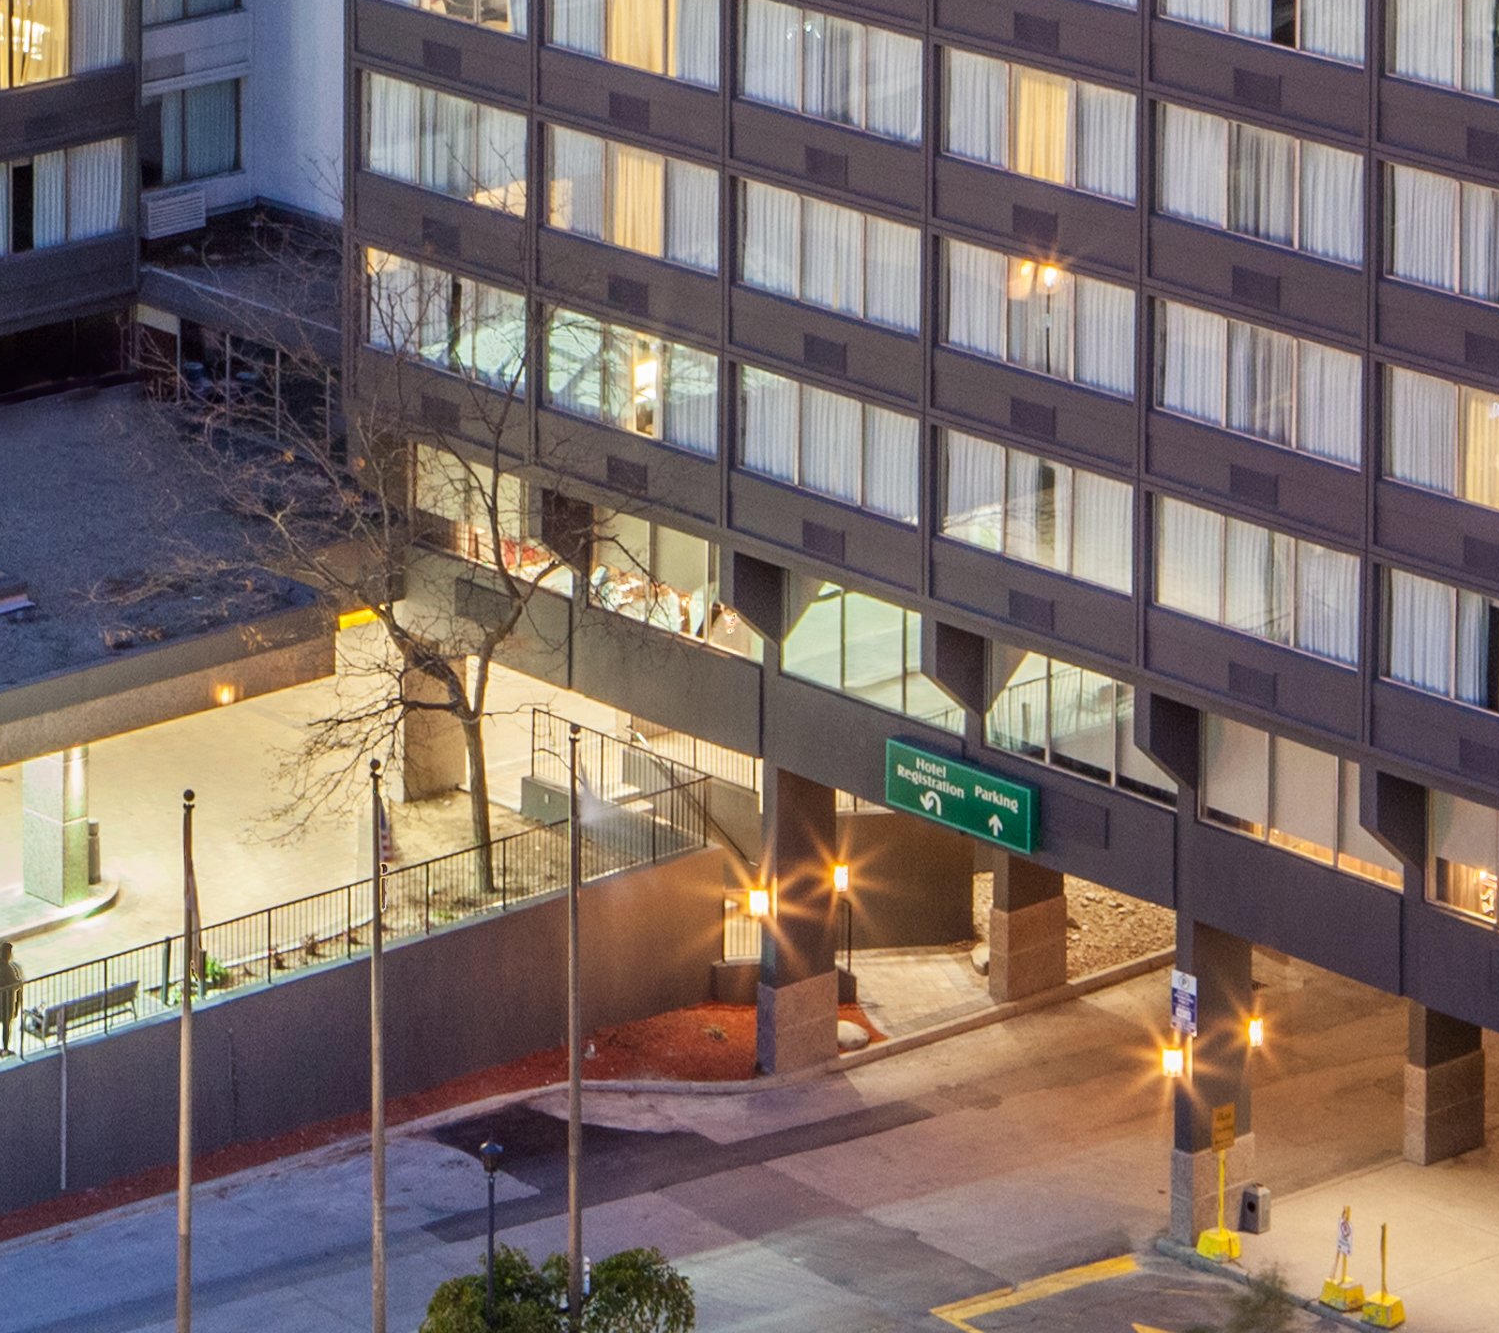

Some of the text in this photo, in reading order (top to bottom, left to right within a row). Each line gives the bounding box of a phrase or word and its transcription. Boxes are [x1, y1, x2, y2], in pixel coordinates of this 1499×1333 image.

[896, 764, 965, 799] Registration
[915, 756, 947, 778] Hotel
[974, 785, 1019, 815] Parking
